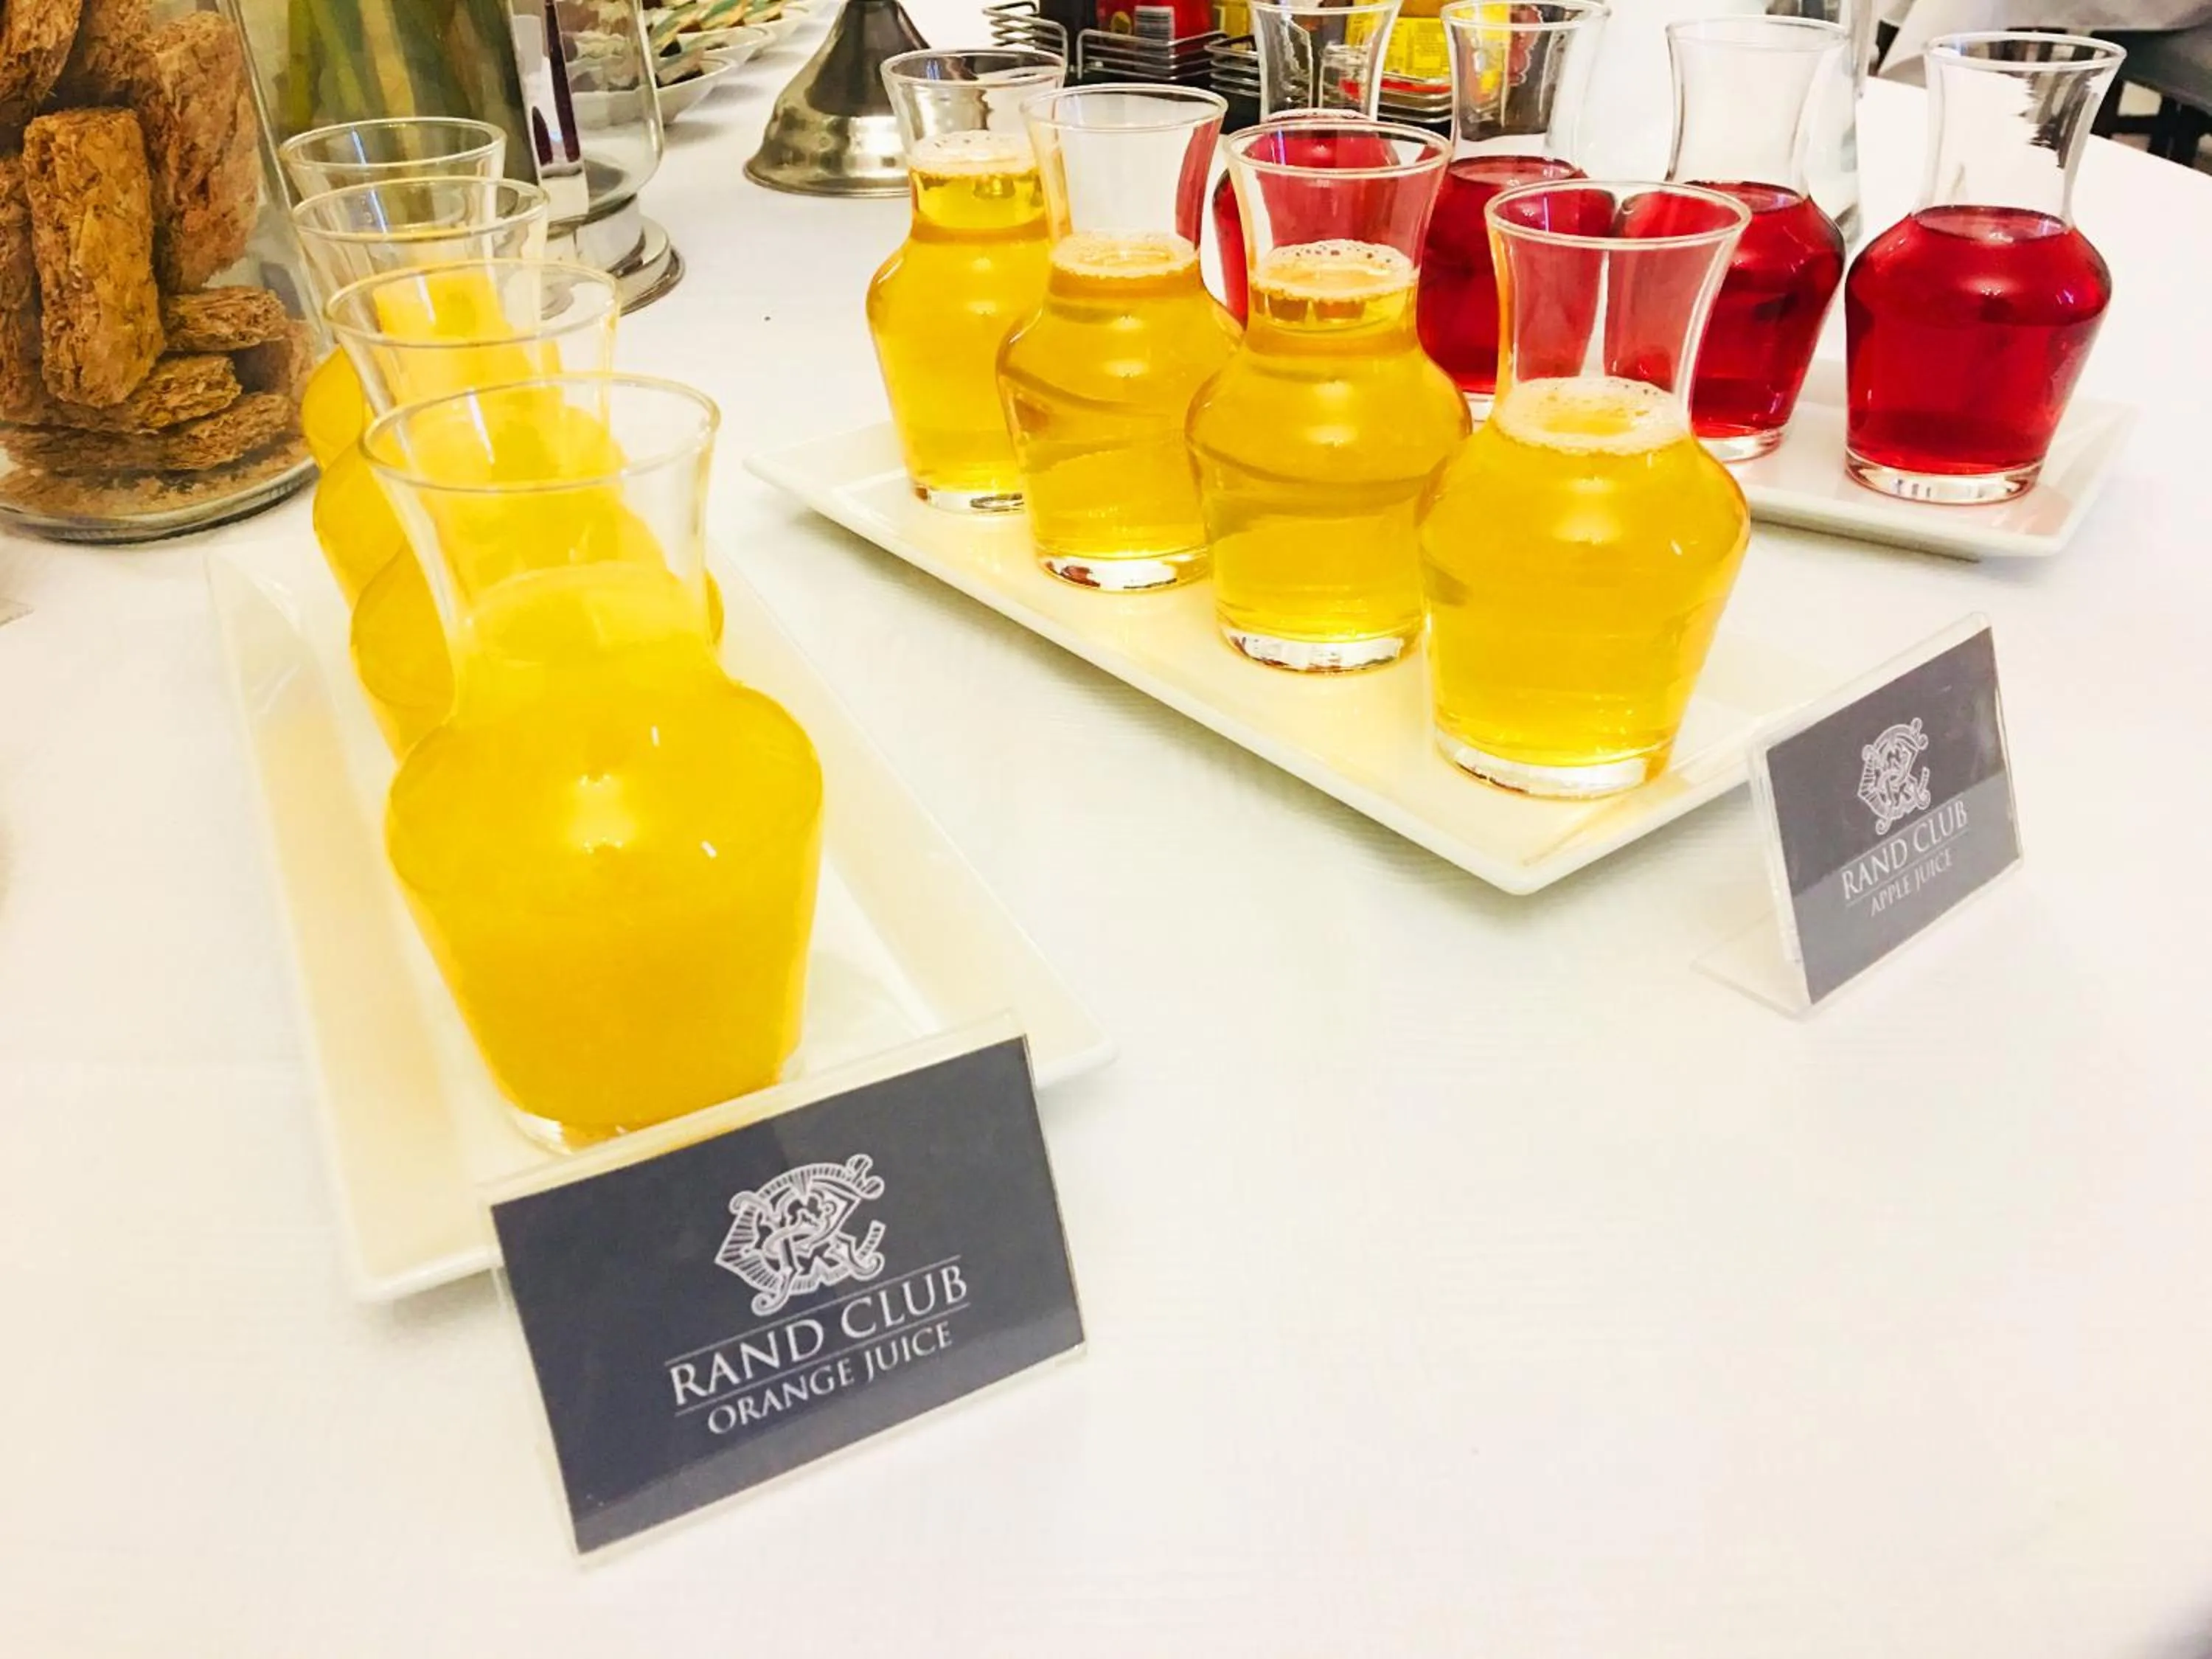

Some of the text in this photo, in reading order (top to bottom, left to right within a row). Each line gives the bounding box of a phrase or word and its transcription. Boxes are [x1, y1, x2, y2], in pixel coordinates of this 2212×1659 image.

[1842, 800, 1967, 900] RAND CLUB
[1871, 848, 1953, 917] APPLE JUICE
[669, 1265, 967, 1405] RAND CLUB
[708, 1321, 953, 1434] ORANGE JUICE
